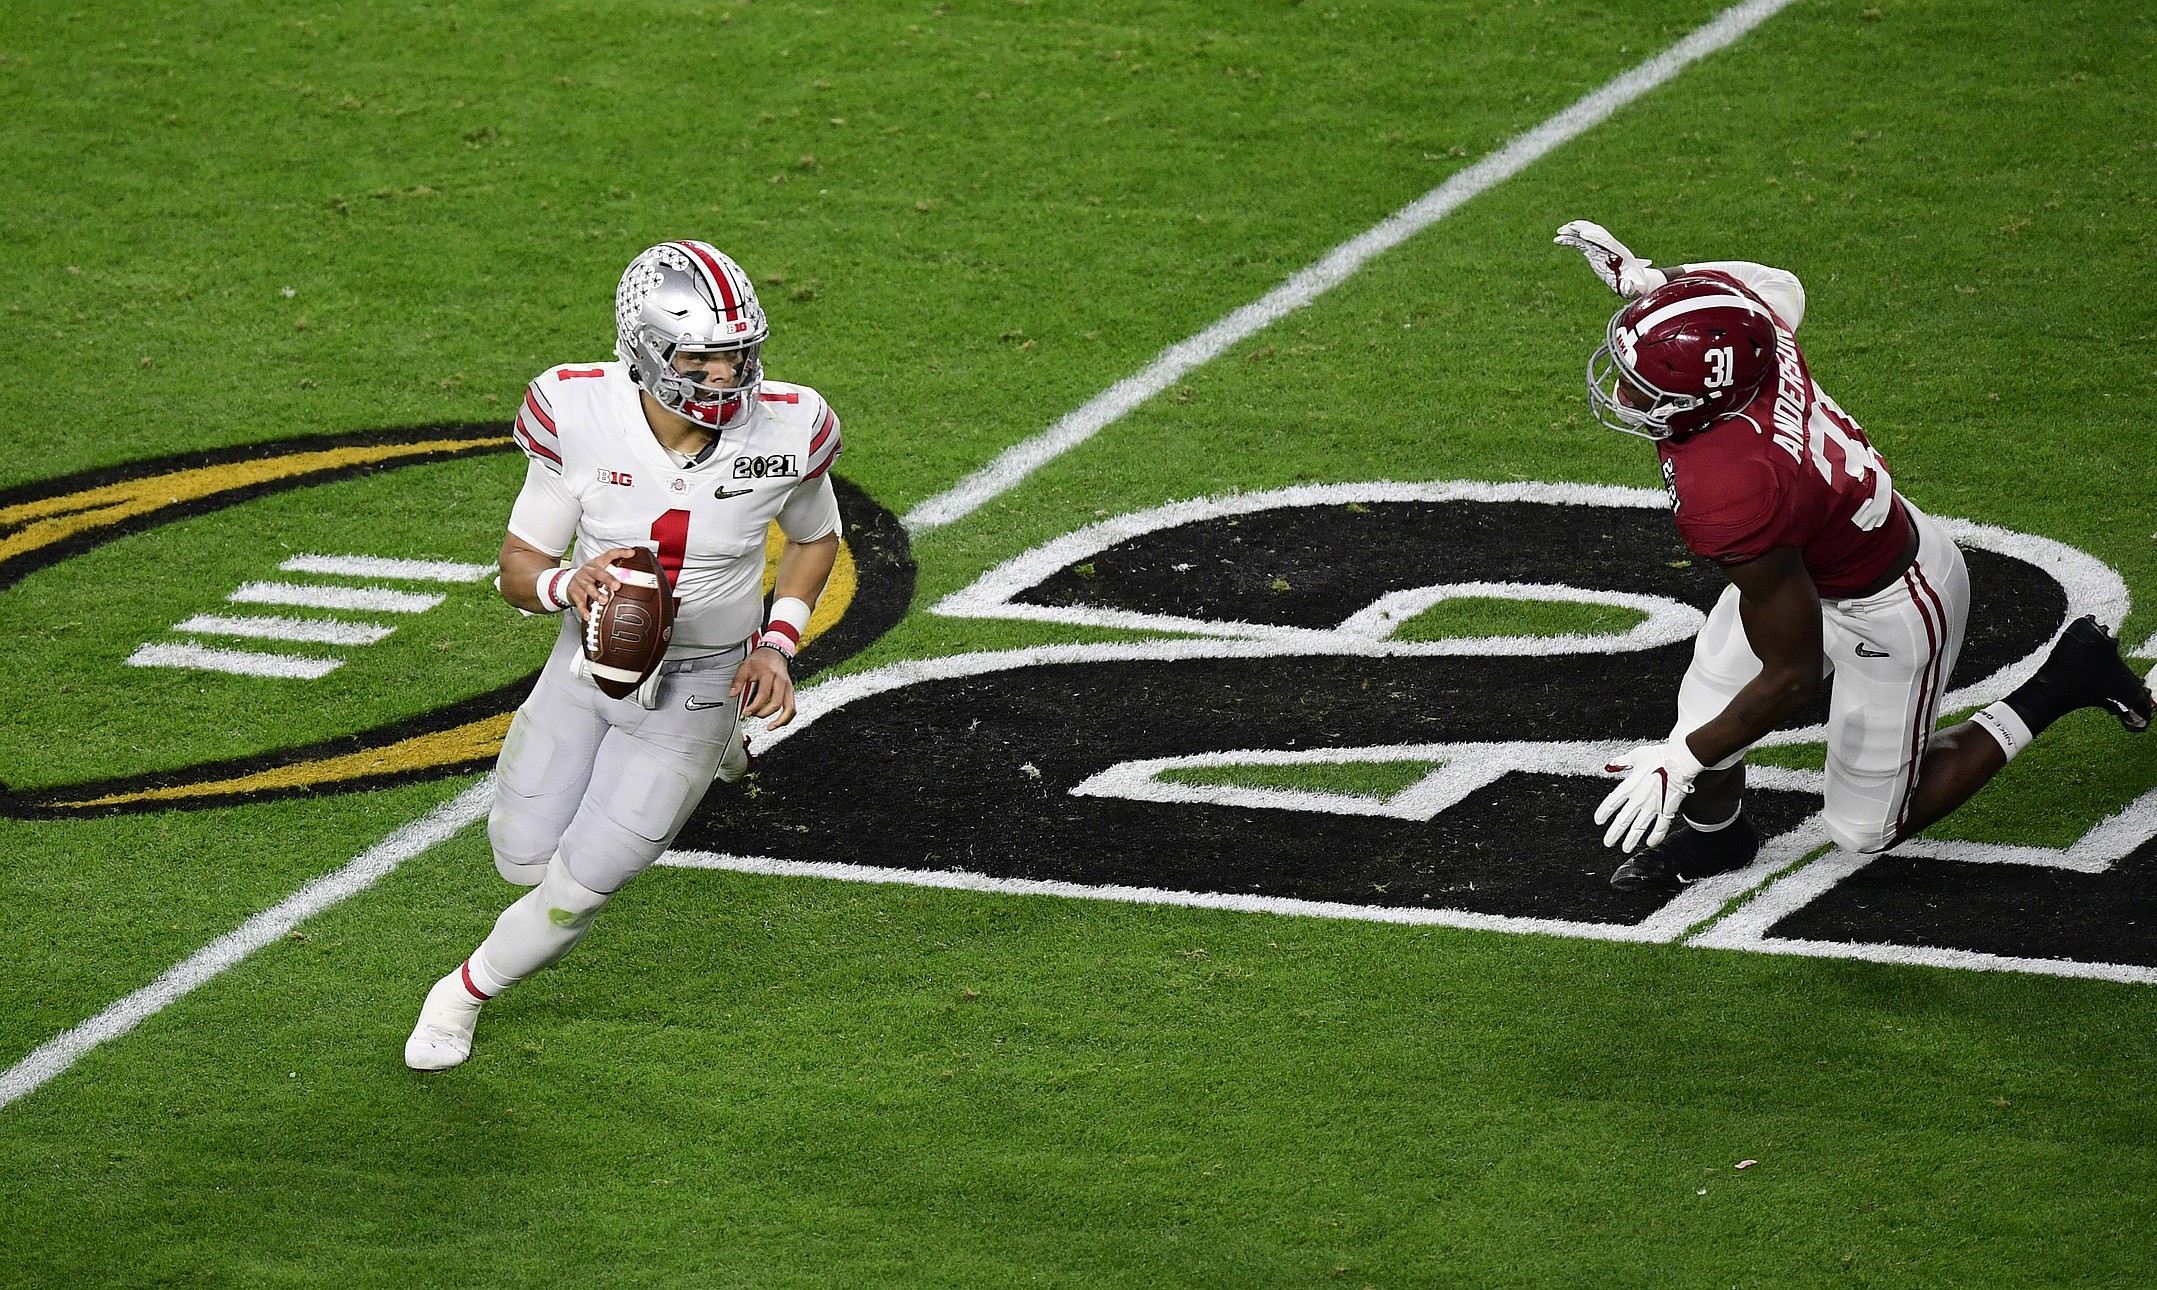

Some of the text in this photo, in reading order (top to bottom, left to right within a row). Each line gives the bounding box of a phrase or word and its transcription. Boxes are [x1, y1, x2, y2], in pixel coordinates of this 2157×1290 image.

[556, 368, 605, 381] 1
[1703, 345, 1734, 388] 31
[1772, 325, 1805, 465] ANDERSON
[733, 454, 799, 479] 2021
[650, 508, 691, 618] 1
